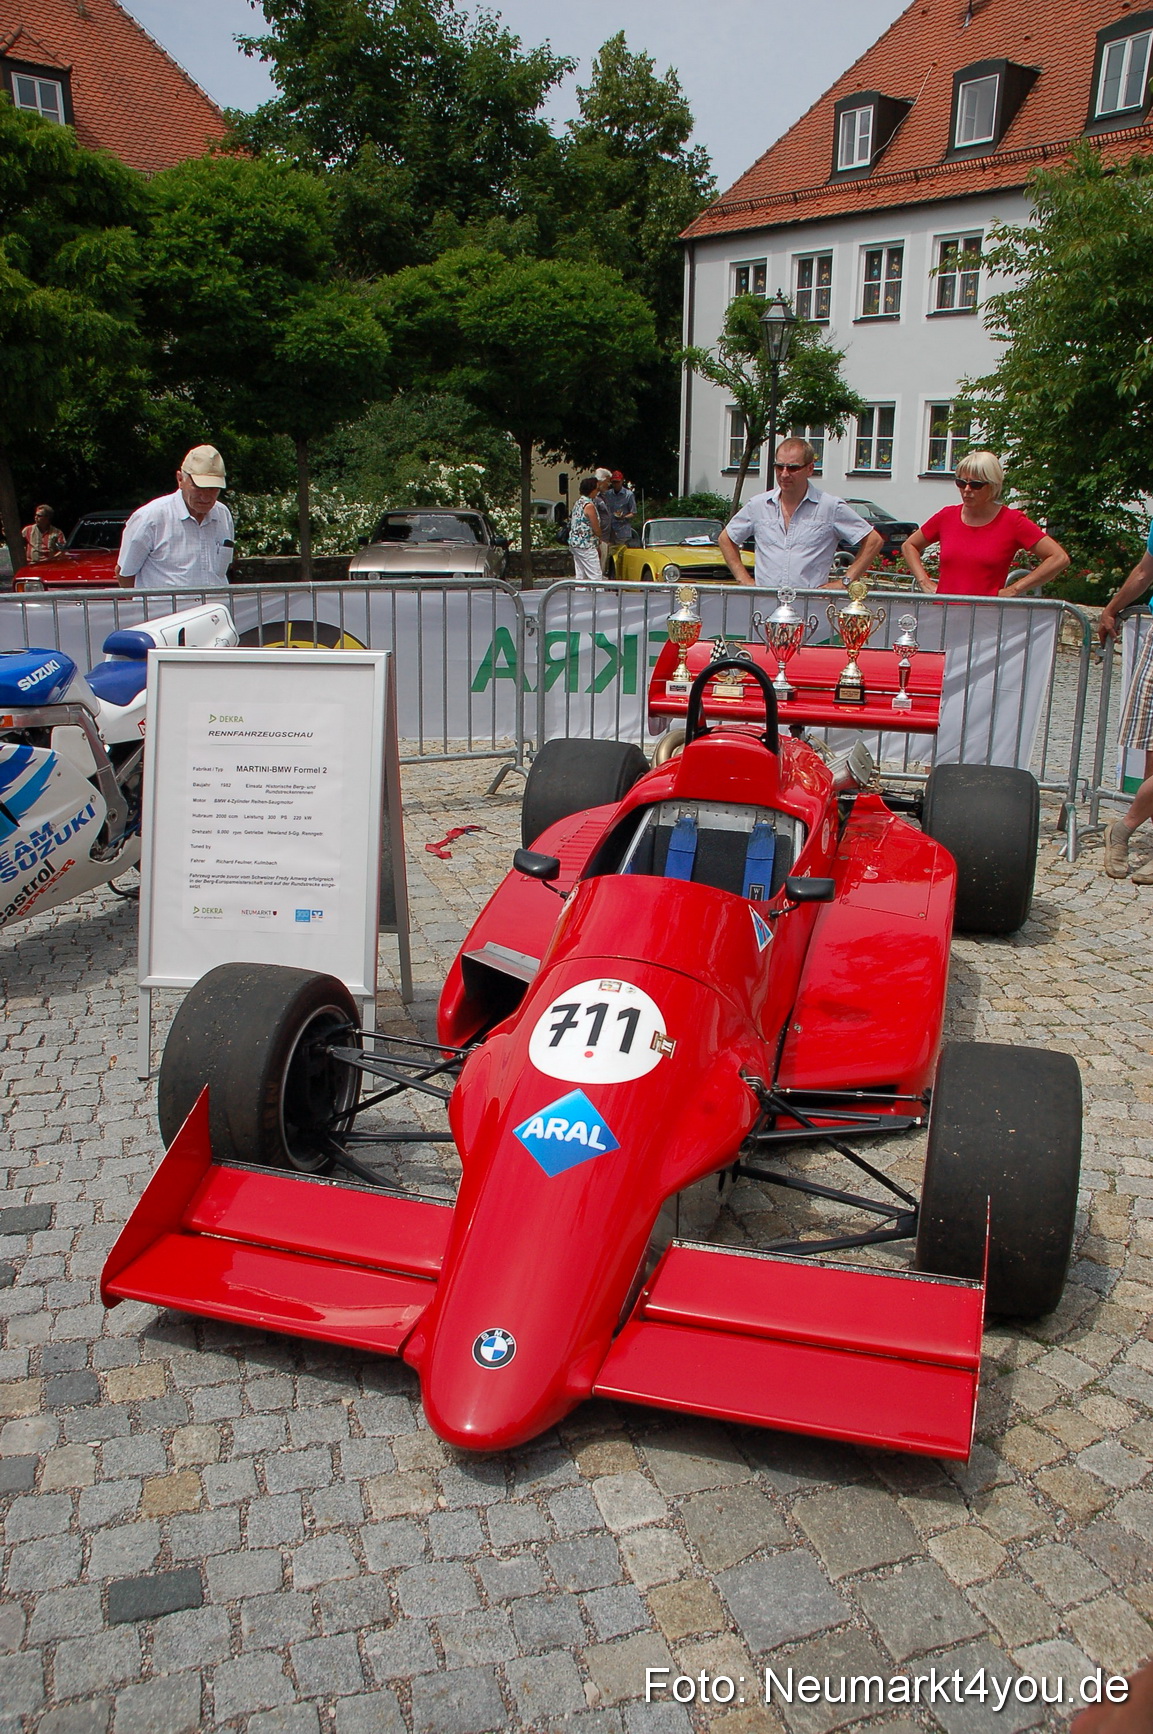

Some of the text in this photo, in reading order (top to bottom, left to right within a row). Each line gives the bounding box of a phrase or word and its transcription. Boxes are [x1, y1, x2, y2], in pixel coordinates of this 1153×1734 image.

[18, 660, 60, 691] SUZUKI
[0, 803, 96, 883] SUZUKI
[0, 822, 54, 869] EAM
[550, 1002, 641, 1054] 711
[522, 1117, 606, 1150] ARAL
[480, 1330, 514, 1345] BMW
